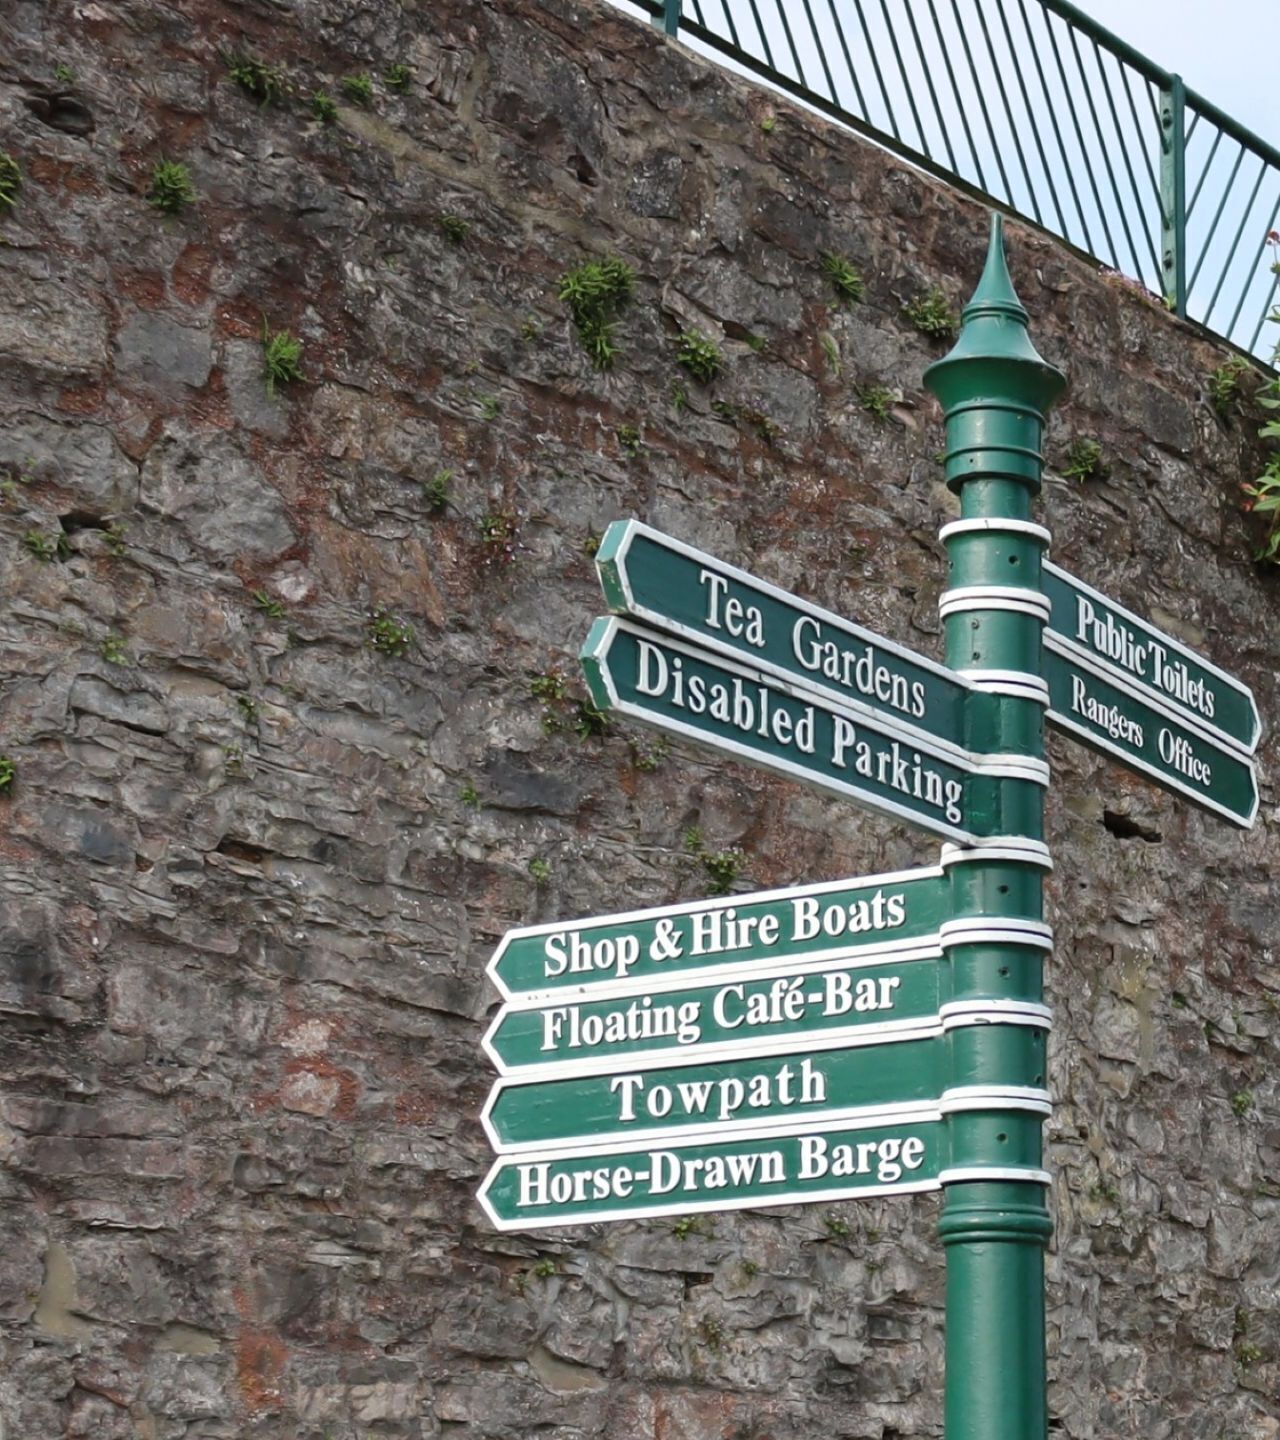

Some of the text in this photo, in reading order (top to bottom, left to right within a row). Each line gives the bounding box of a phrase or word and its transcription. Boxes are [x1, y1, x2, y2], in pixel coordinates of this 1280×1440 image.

[698, 570, 927, 719] Tea Gardens
[1075, 595, 1216, 719] Public Toilets
[634, 640, 964, 825] Disabled Parking
[1070, 675, 1212, 787] Rangers Office
[543, 892, 906, 978] Shop & Hire Boats
[540, 972, 901, 1051] Floating Café-Bar
[610, 1058, 827, 1122] Towpath
[516, 1135, 925, 1207] Horse-Drawn Barge
